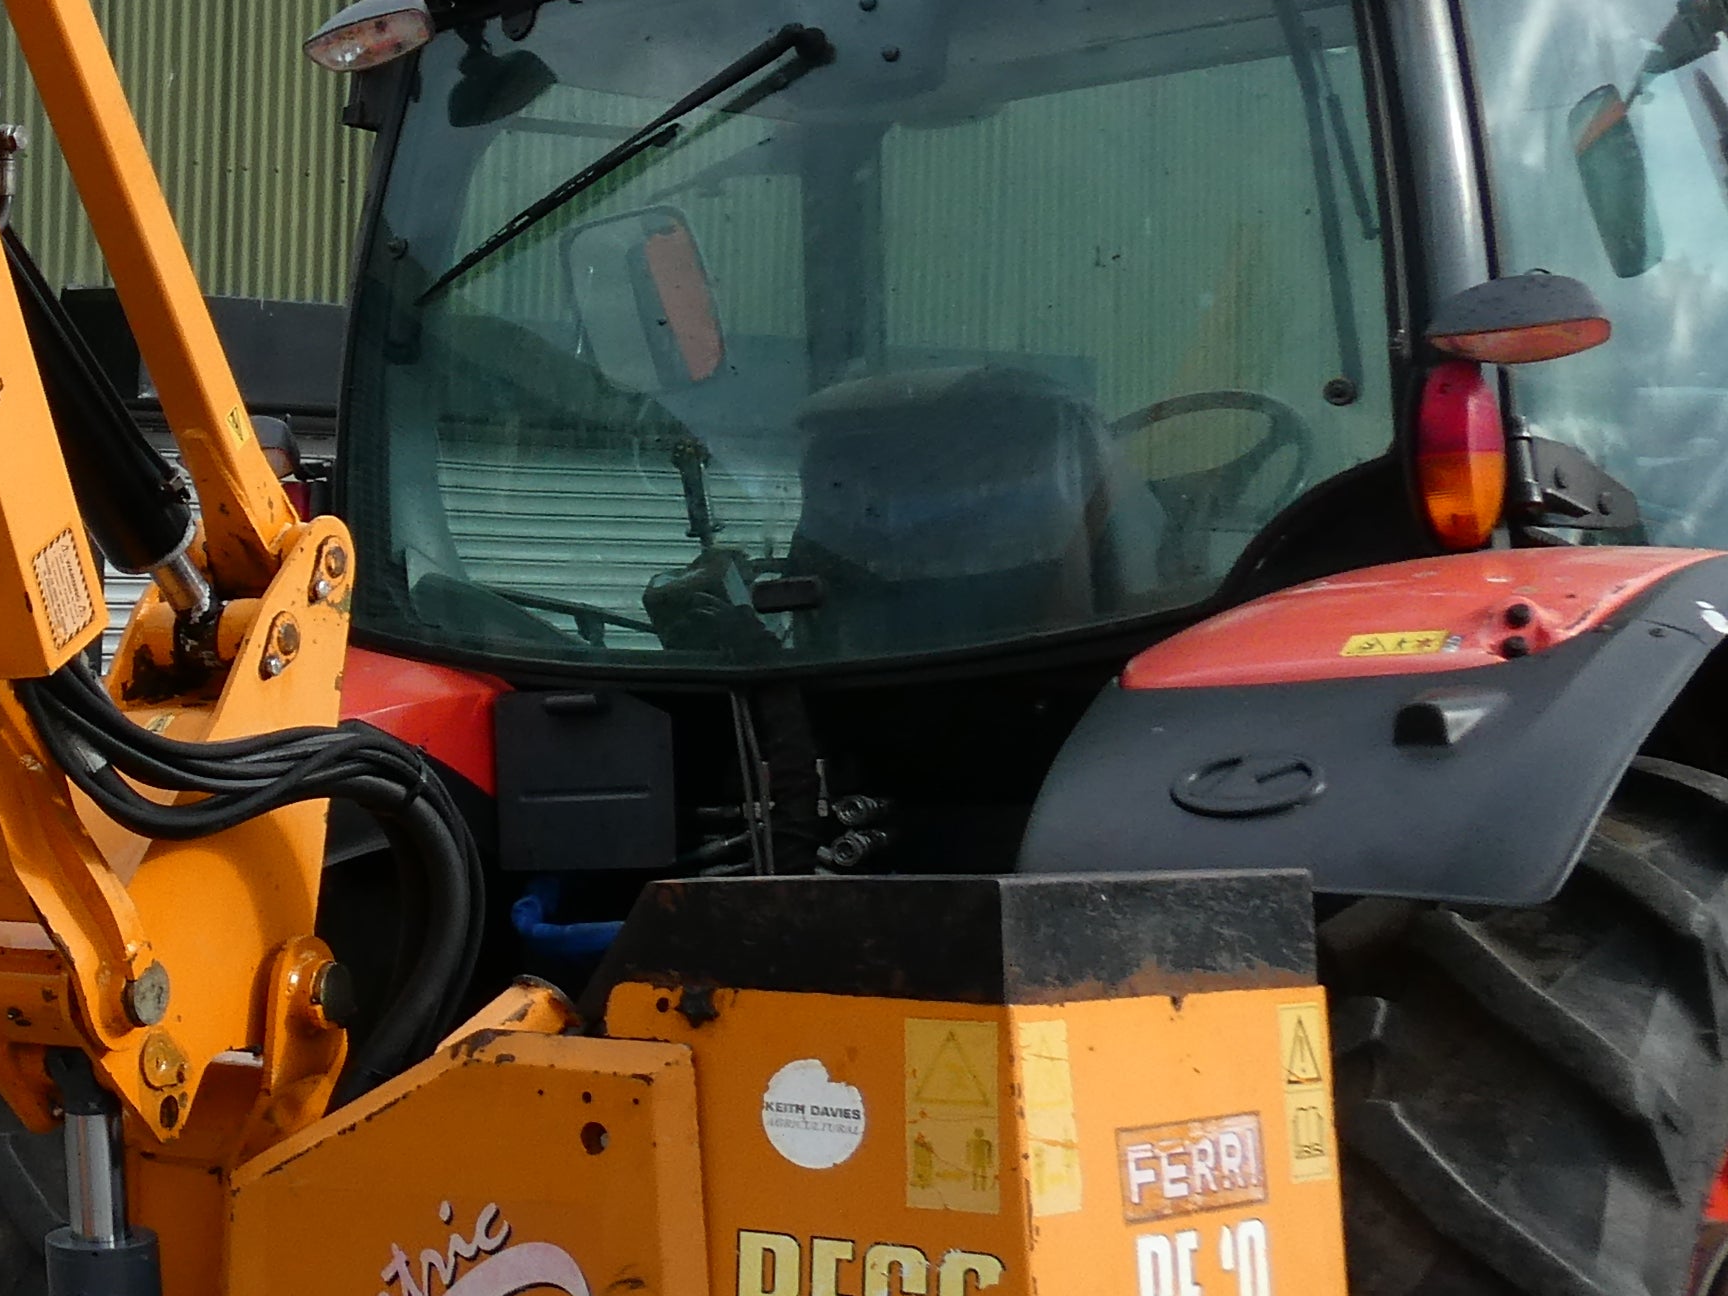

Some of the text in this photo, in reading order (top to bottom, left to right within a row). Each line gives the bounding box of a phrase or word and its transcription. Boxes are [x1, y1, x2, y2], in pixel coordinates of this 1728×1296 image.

[764, 1101, 862, 1120] KEITH DAVIES
[1125, 1128, 1264, 1205] FERRI
